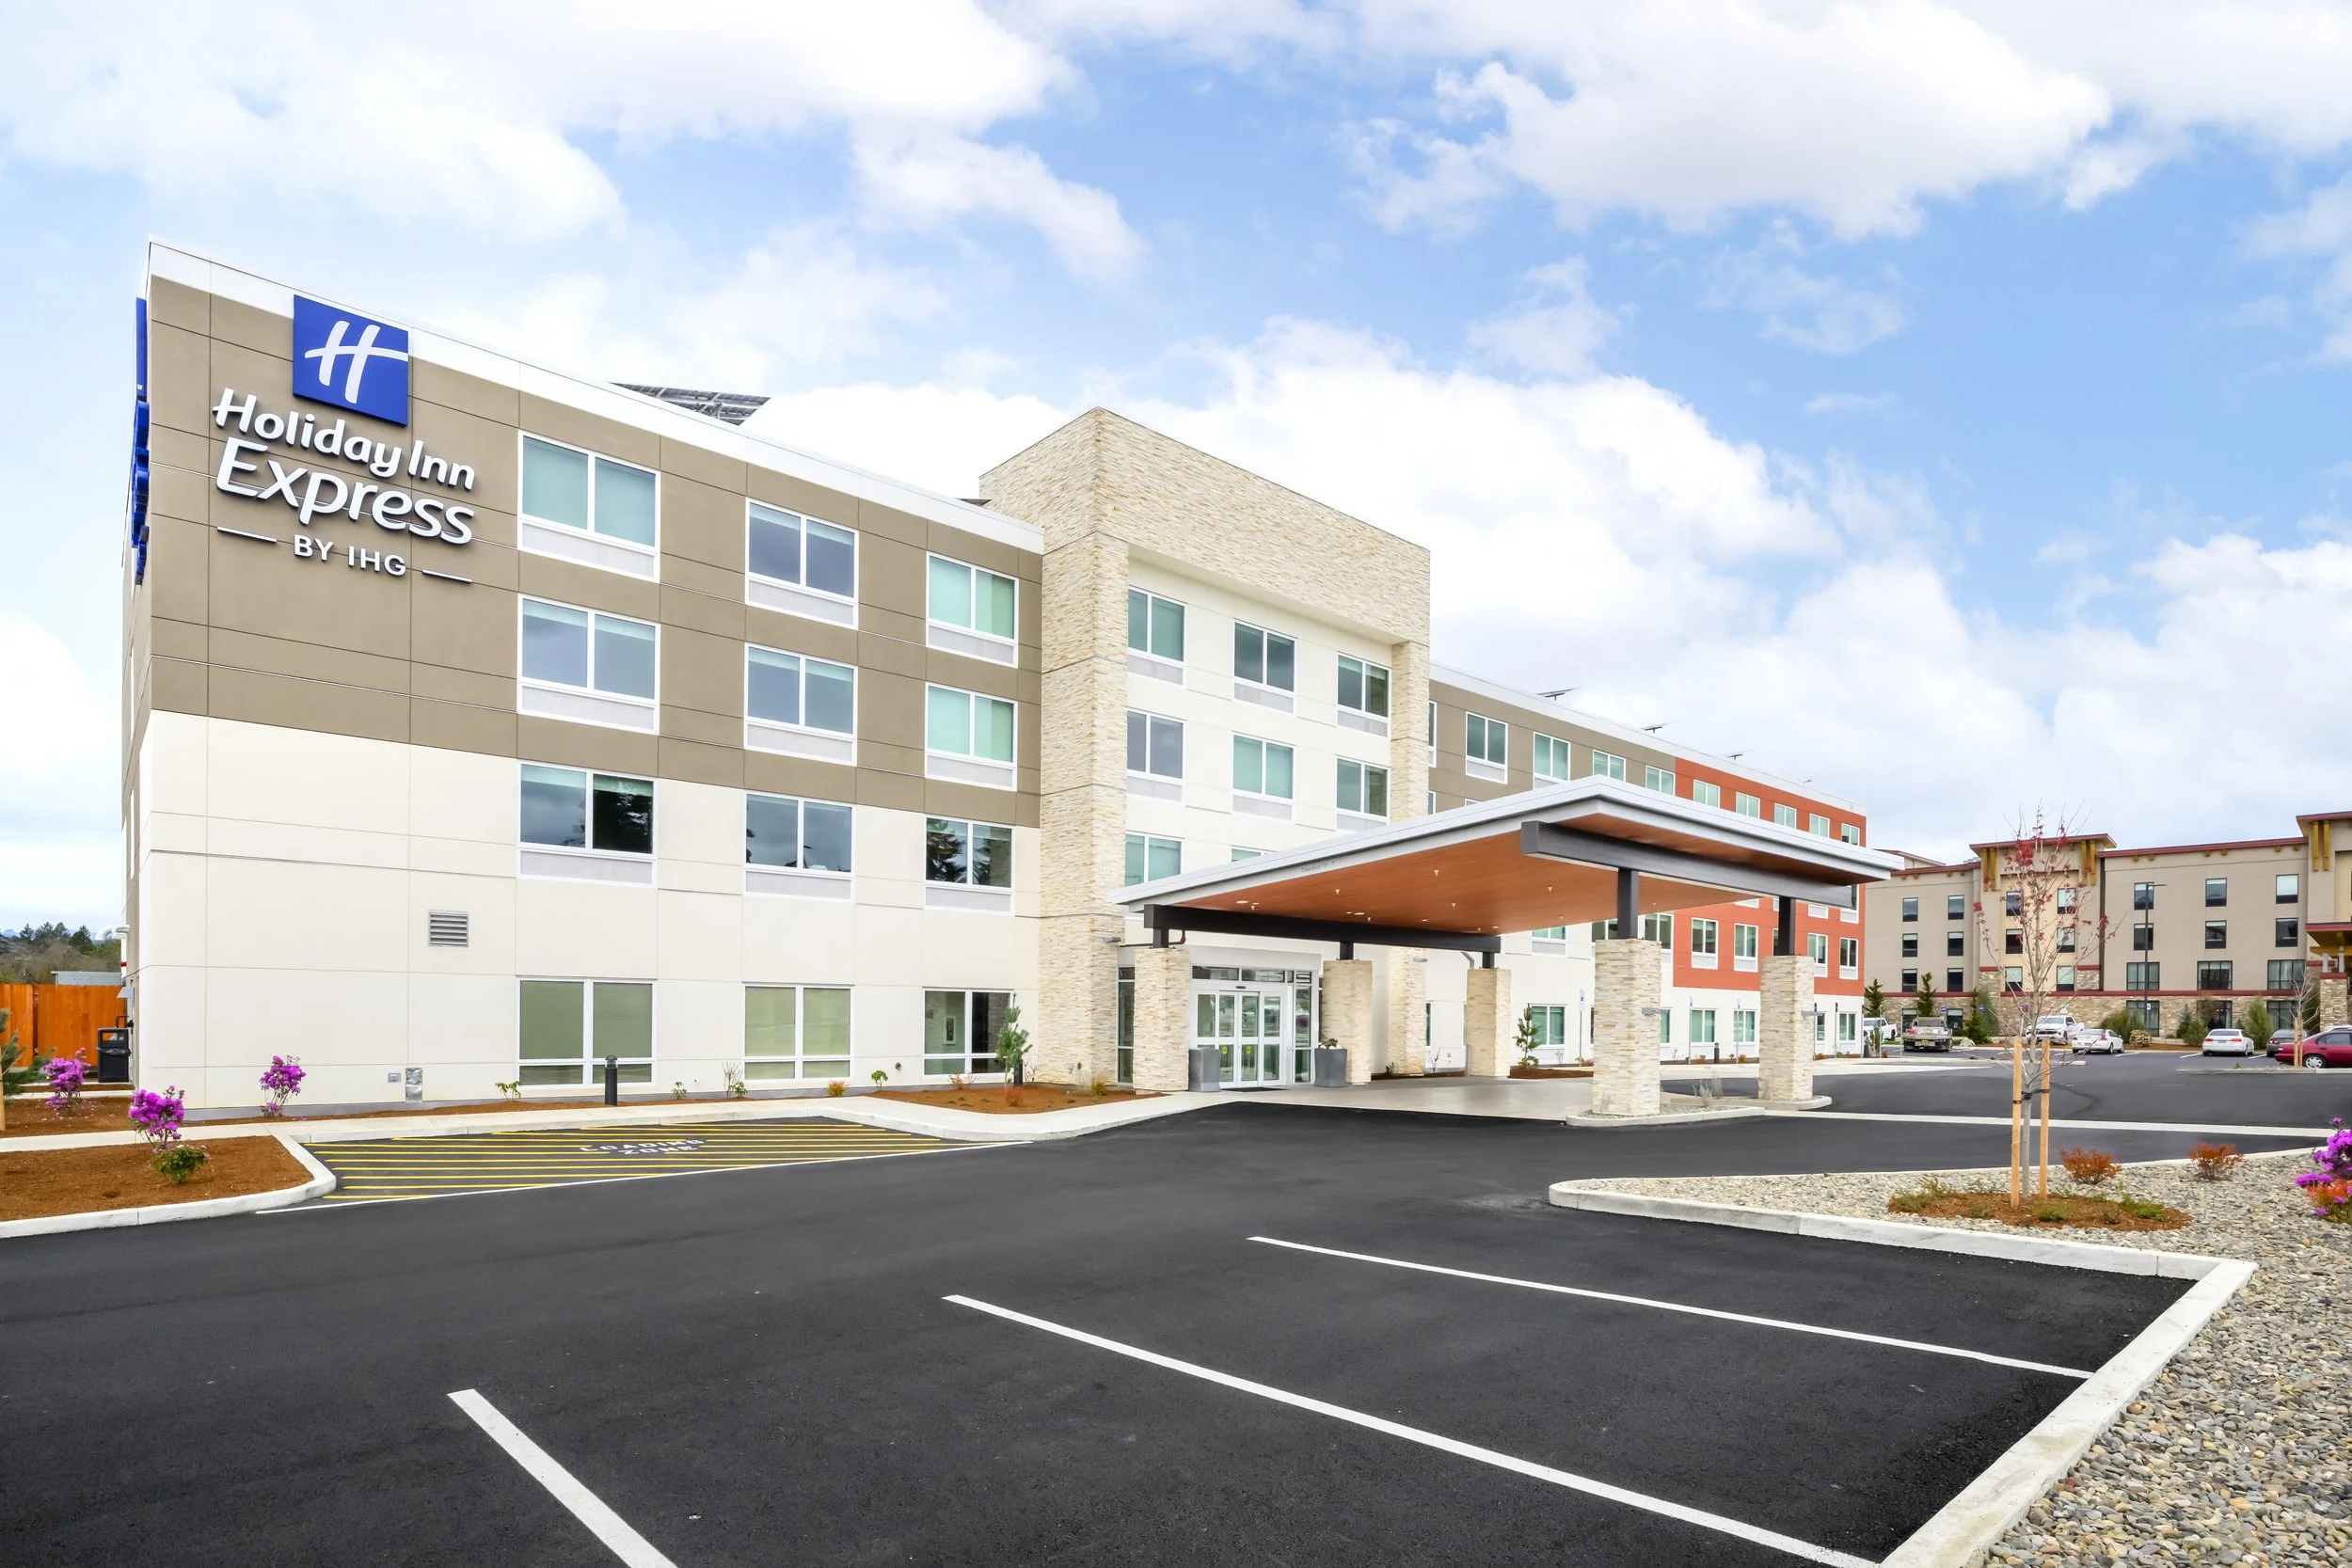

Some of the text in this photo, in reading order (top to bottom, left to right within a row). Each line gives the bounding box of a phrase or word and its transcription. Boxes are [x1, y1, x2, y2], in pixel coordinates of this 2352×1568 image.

[304, 320, 408, 404] H
[213, 388, 475, 490] Holiday Inn
[216, 436, 474, 546] Express
[294, 534, 406, 577] BY IHG
[580, 1139, 705, 1151] LOADING
[618, 1145, 698, 1155] ZONE
